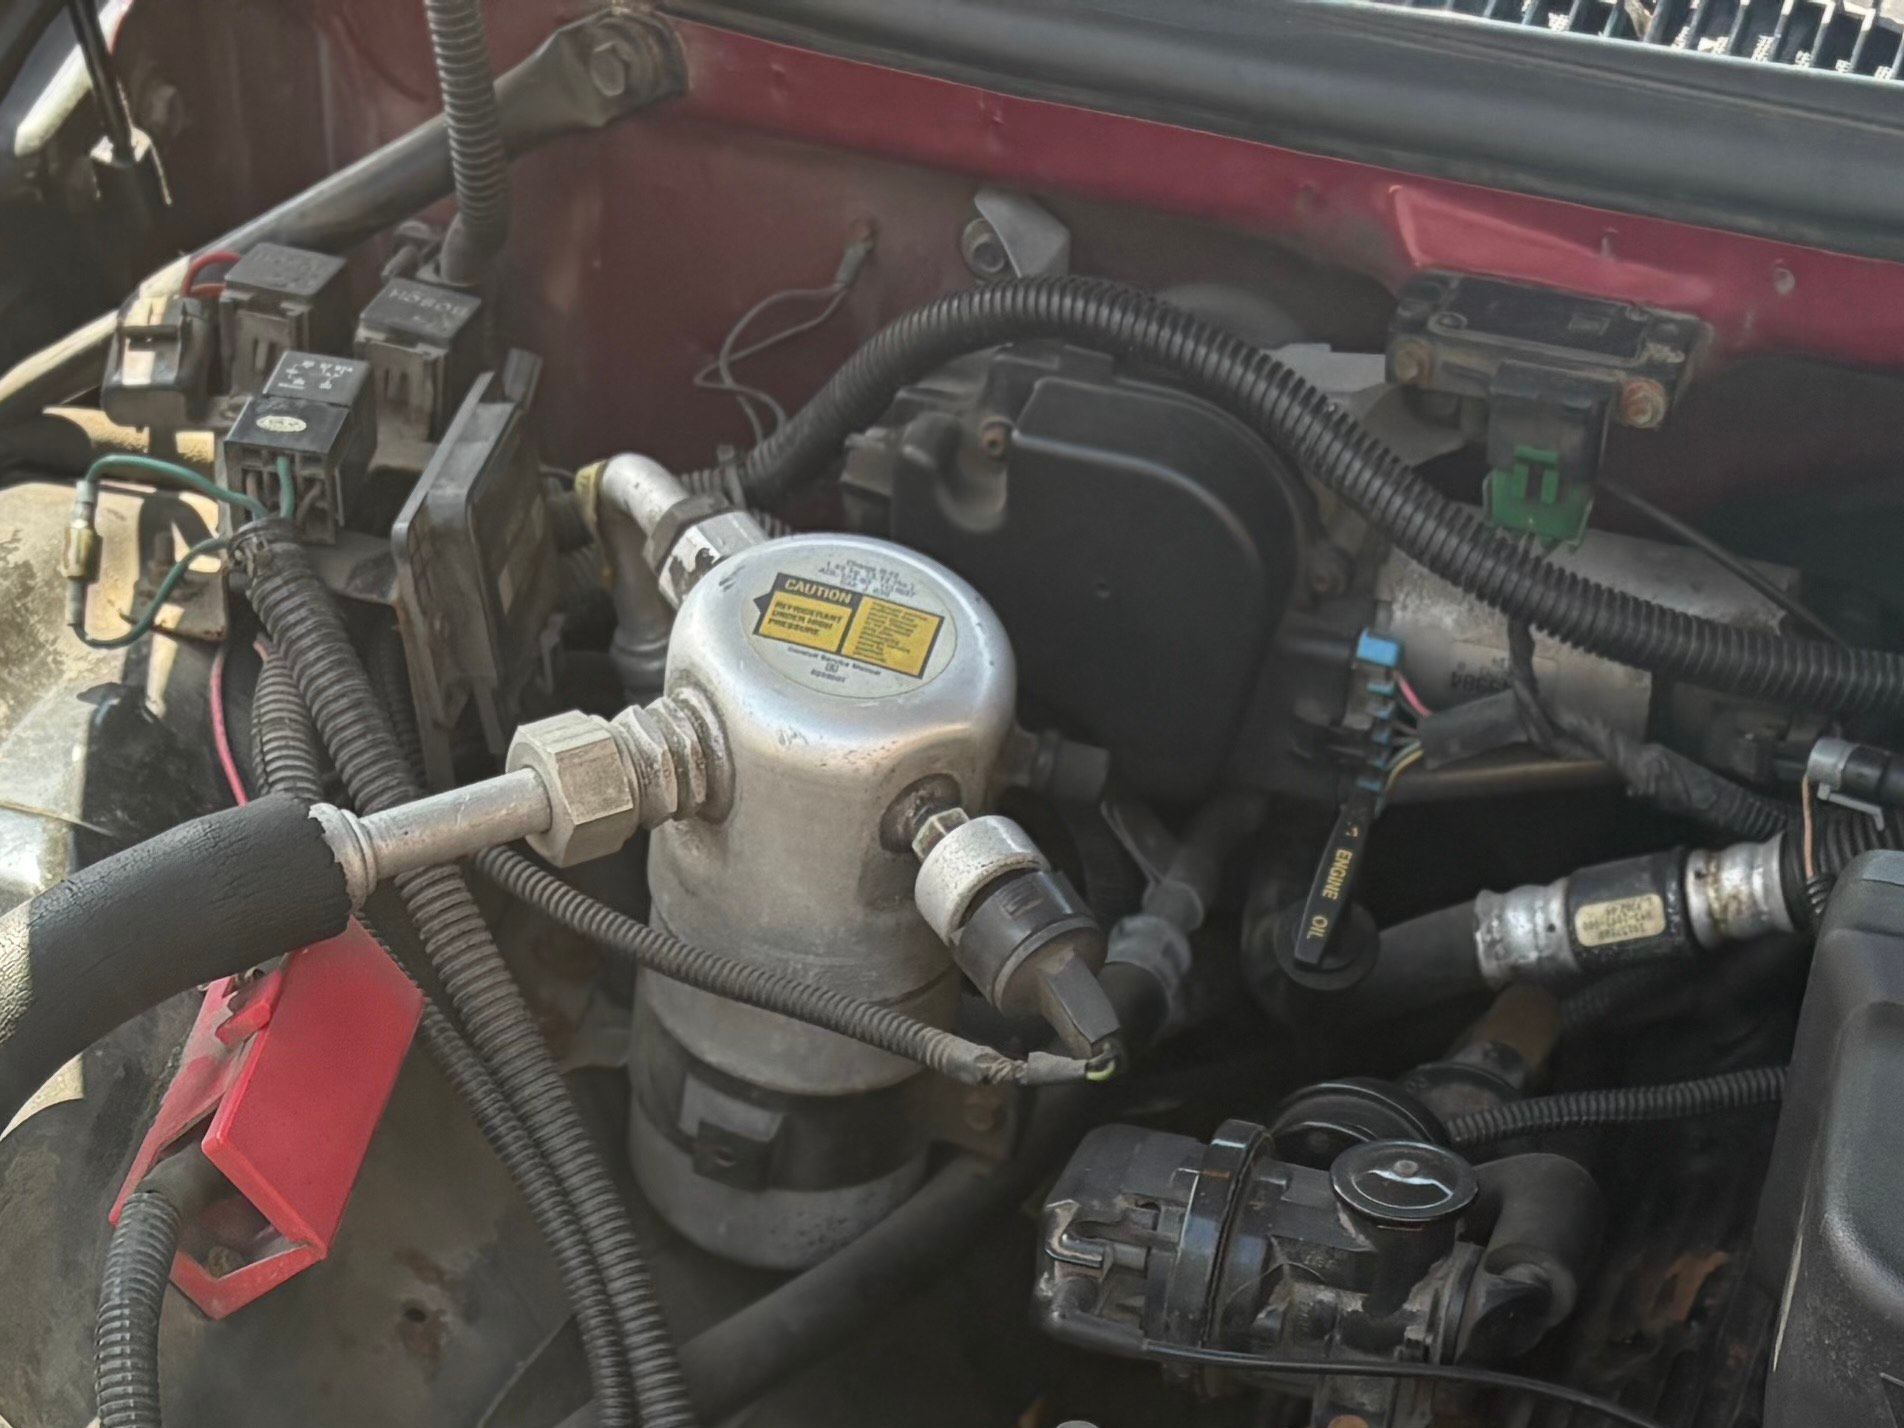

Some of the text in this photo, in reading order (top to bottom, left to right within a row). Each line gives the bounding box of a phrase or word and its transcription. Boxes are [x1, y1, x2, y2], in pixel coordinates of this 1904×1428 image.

[784, 577, 852, 605] CAUTION
[1306, 849, 1352, 941] ENGINE OIL
